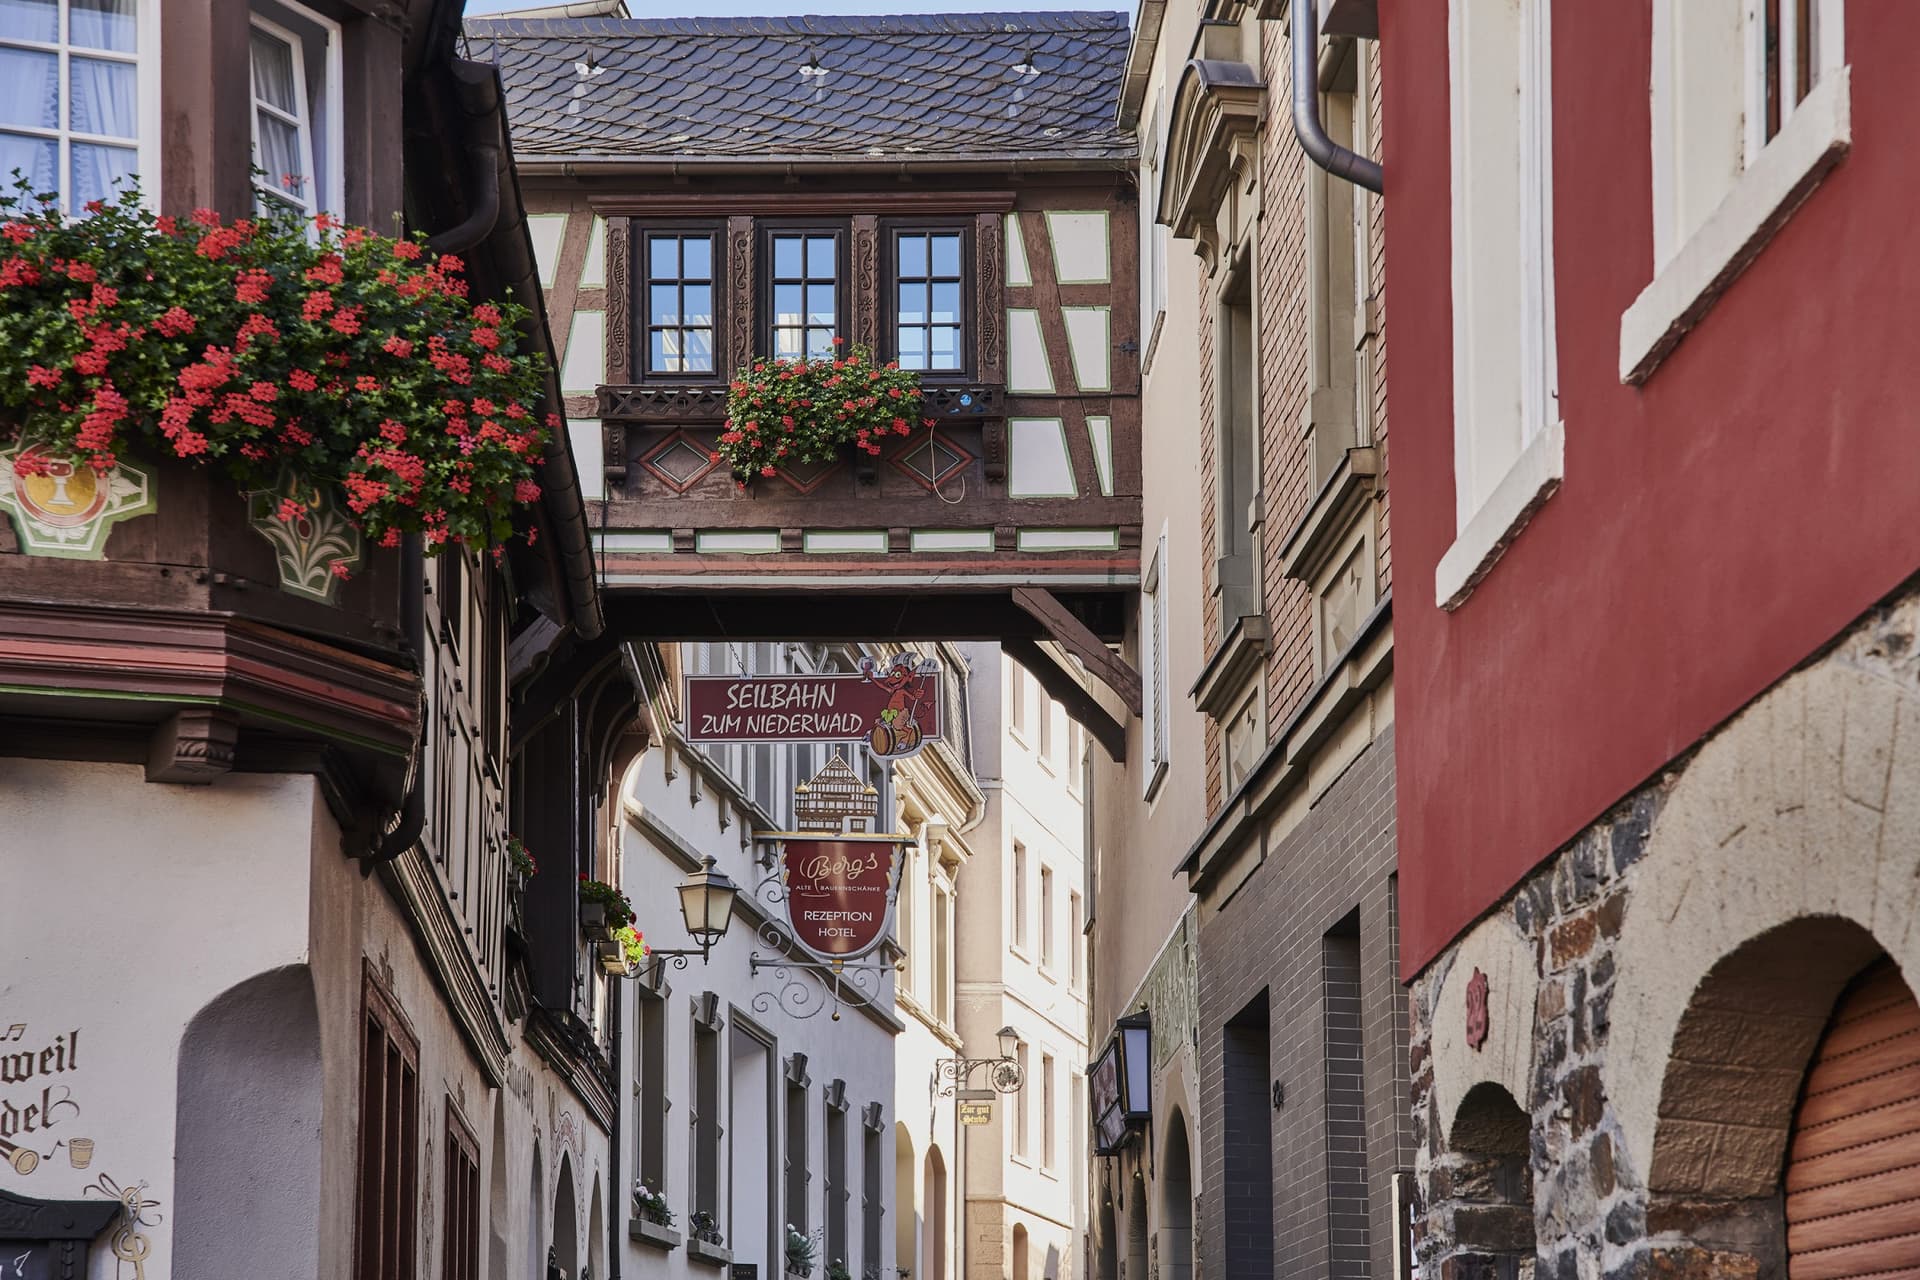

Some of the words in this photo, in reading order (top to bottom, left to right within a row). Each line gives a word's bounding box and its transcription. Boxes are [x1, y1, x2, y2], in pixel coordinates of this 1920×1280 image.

[726, 683, 836, 710] SEILBAHN
[700, 714, 741, 735] ZUM
[746, 713, 863, 735] NIEDERWALD
[804, 910, 872, 922] REZEPTION
[818, 927, 857, 938] HOTEL
